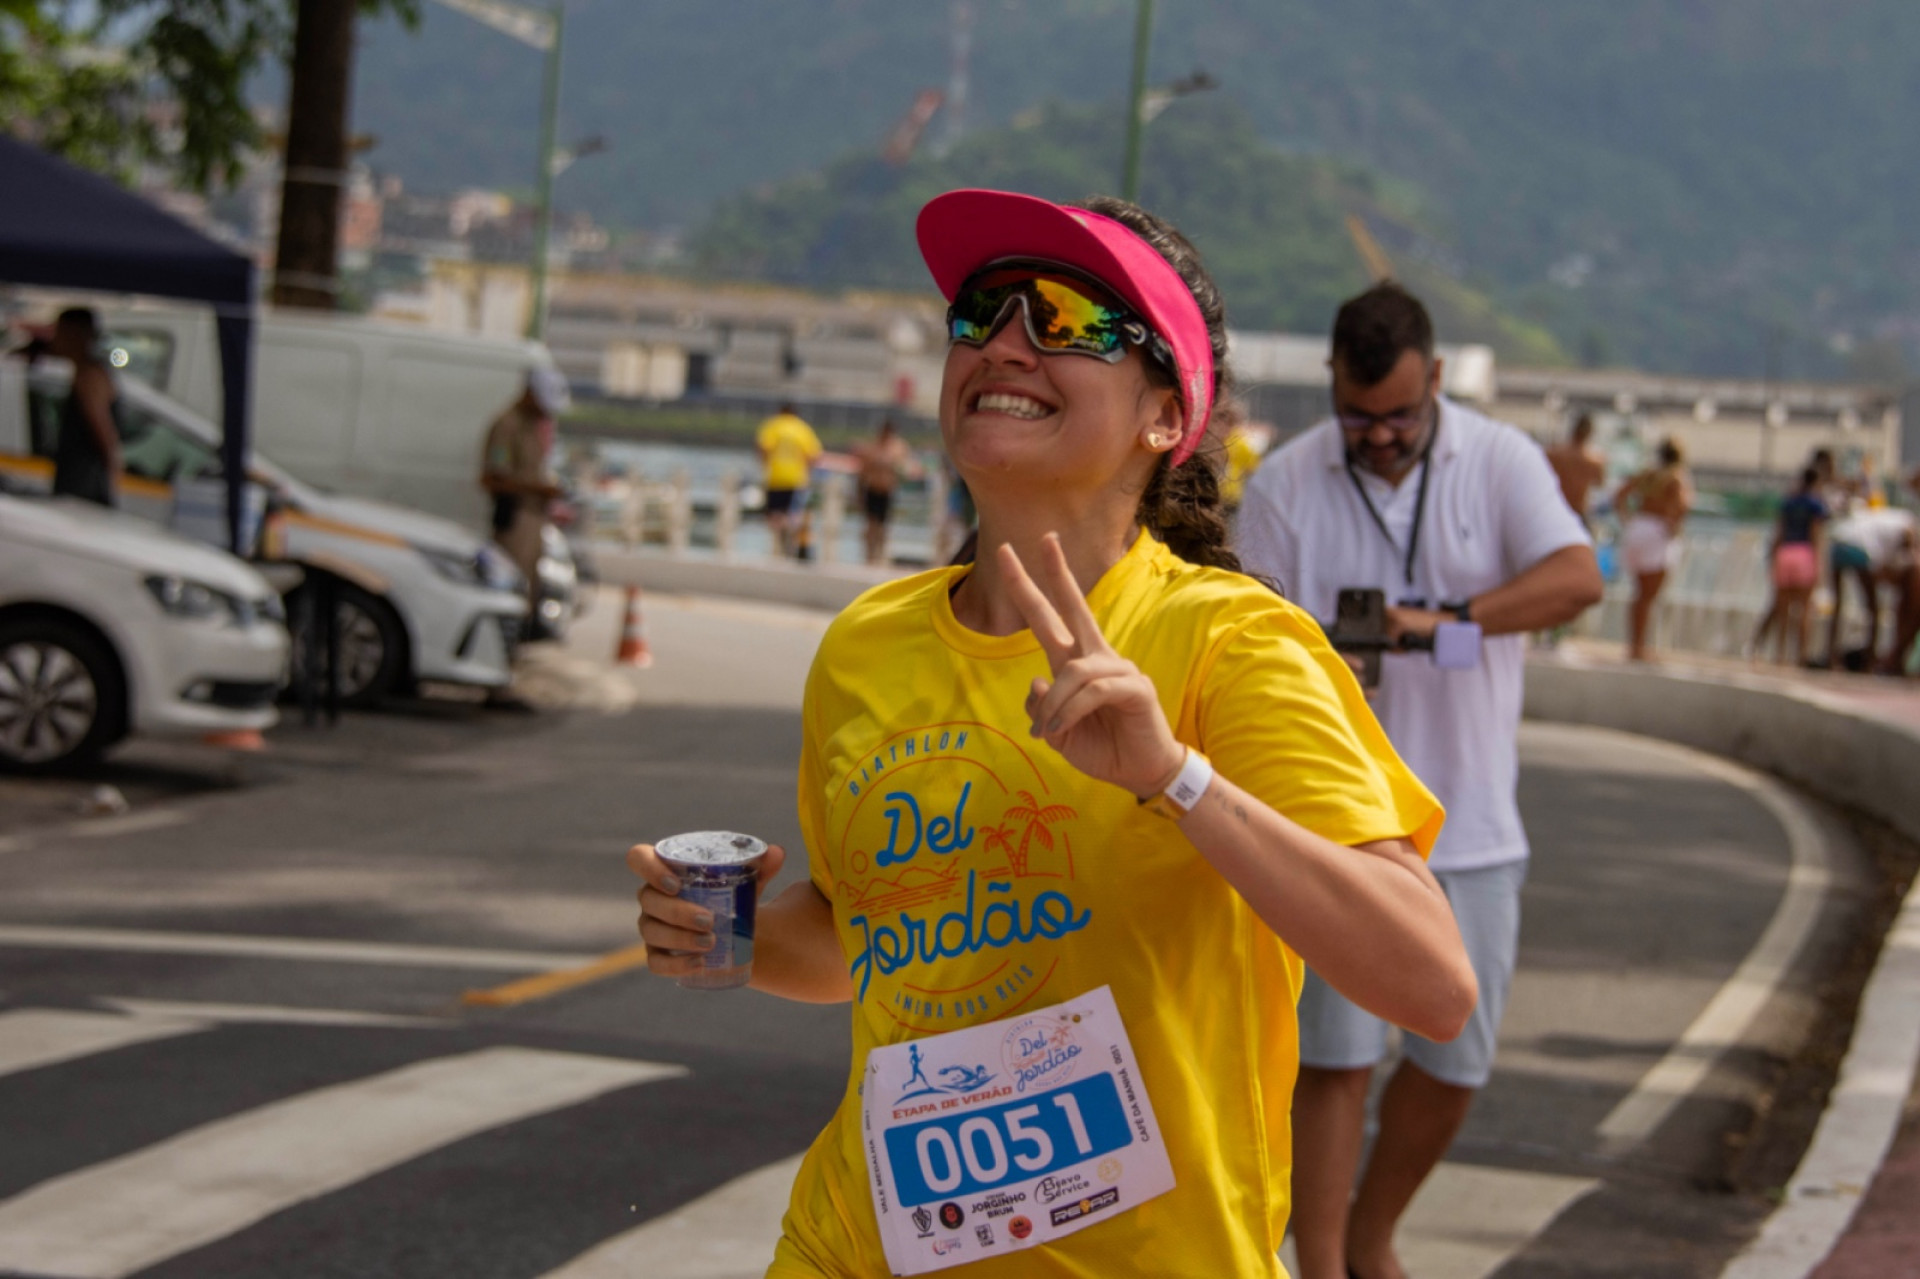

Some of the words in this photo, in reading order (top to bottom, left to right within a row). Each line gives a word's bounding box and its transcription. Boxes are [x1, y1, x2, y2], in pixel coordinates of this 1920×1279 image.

[848, 731, 968, 796] BIATHLON
[875, 781, 974, 867] Del
[850, 869, 1092, 1004] Jordão
[1019, 1030, 1047, 1057] Del
[1014, 1045, 1082, 1092] Jordão
[892, 1103, 937, 1120] ETAPA
[941, 1097, 960, 1110] DE
[961, 1085, 1013, 1105] VERÃO
[1131, 1102, 1142, 1117] DA
[916, 1092, 1093, 1193] 0051
[971, 1191, 1027, 1215] JORGINHO
[1042, 1180, 1090, 1201] Service
[986, 1206, 1015, 1219] BRUM
